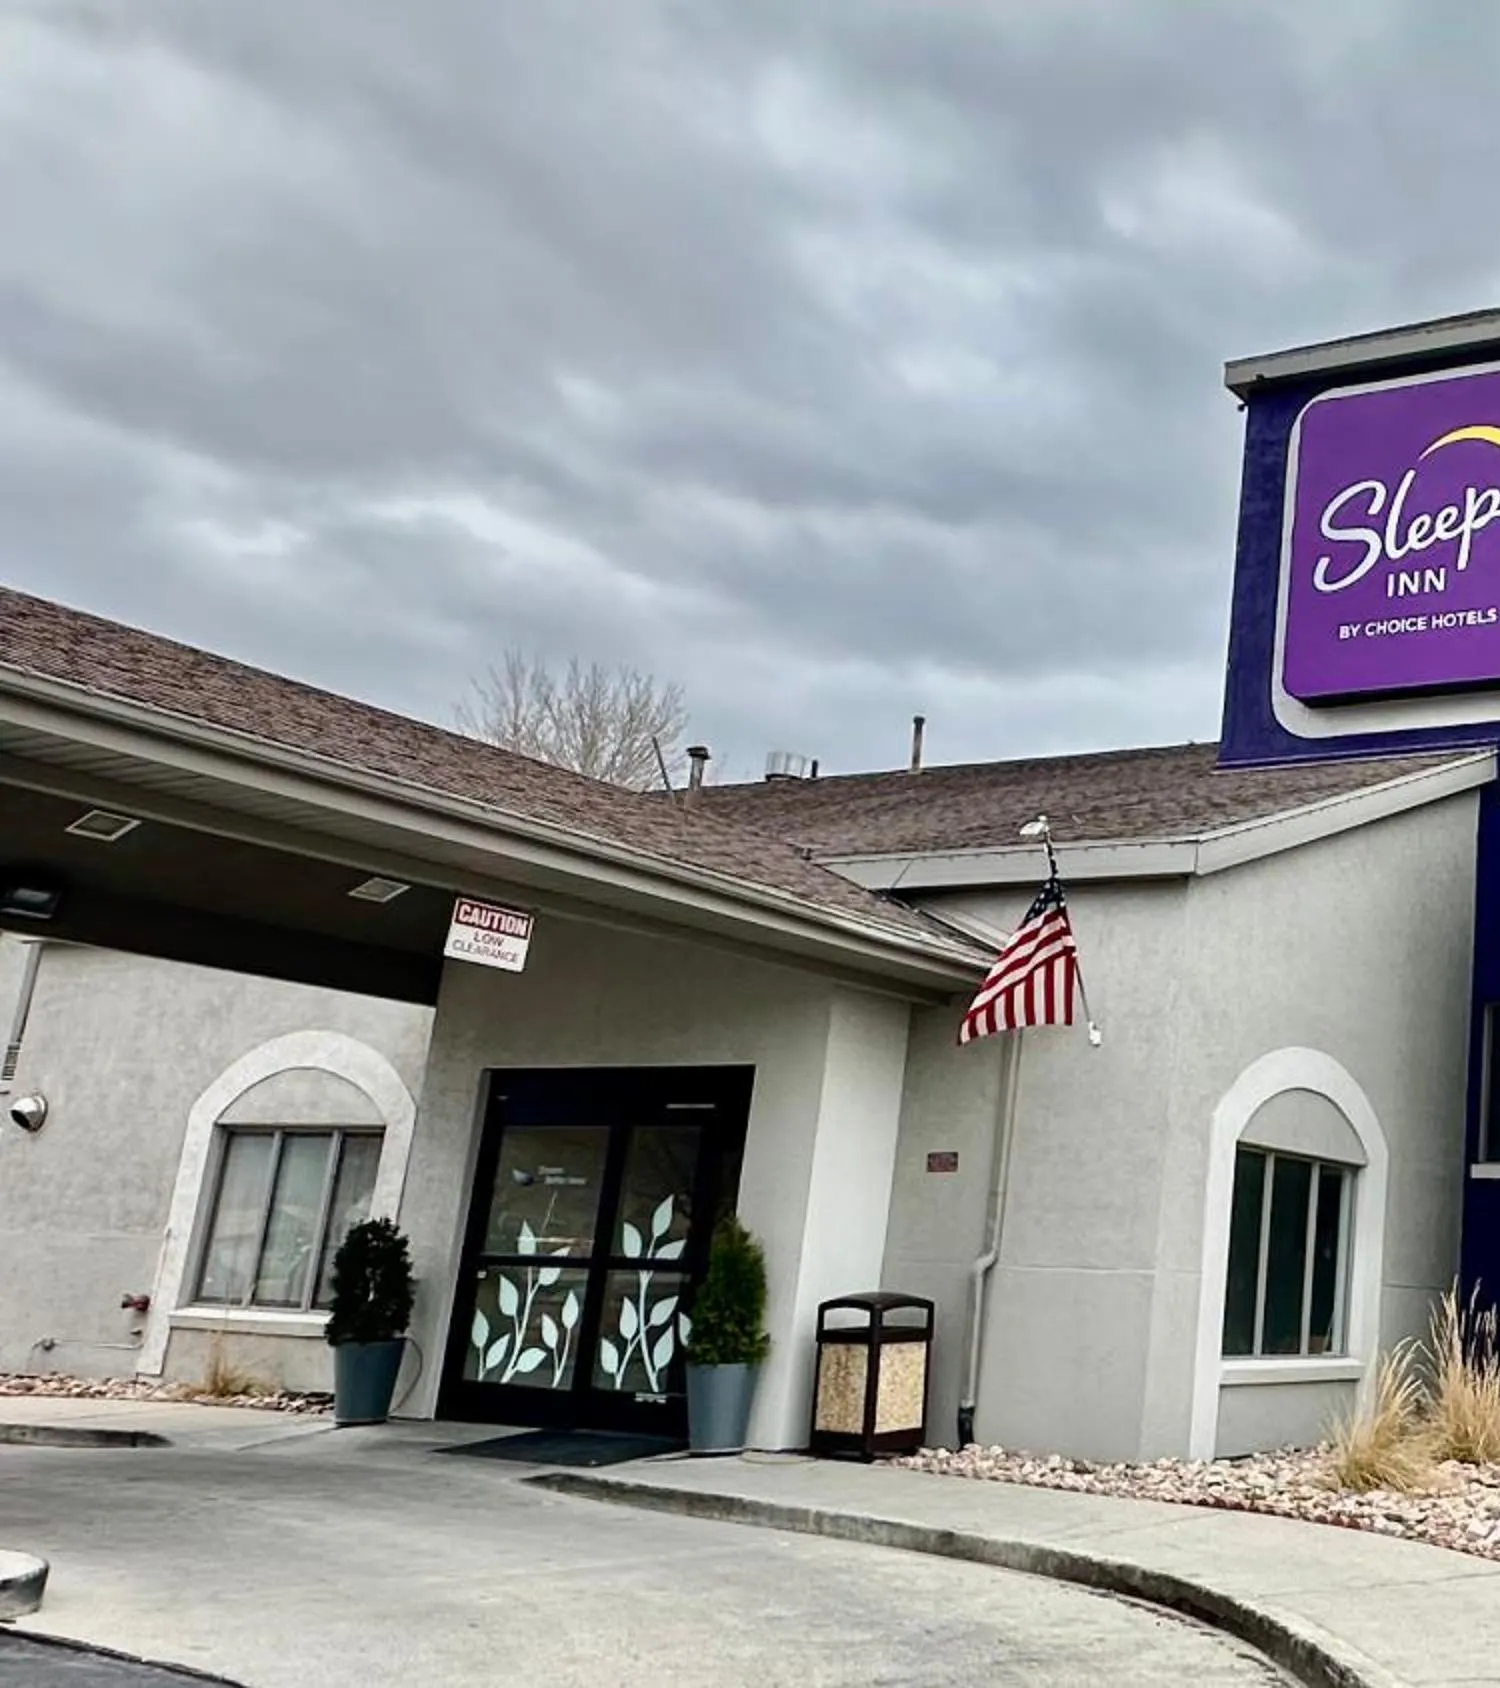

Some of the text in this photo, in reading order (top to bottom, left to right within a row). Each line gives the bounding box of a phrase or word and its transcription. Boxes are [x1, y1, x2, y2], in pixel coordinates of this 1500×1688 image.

[1387, 567, 1447, 598] INN
[1339, 608, 1498, 639] BY CHOICE HOTELS
[458, 903, 529, 937] CAUTION
[452, 939, 520, 963] CLEARANCE
[473, 931, 504, 947] LOW
